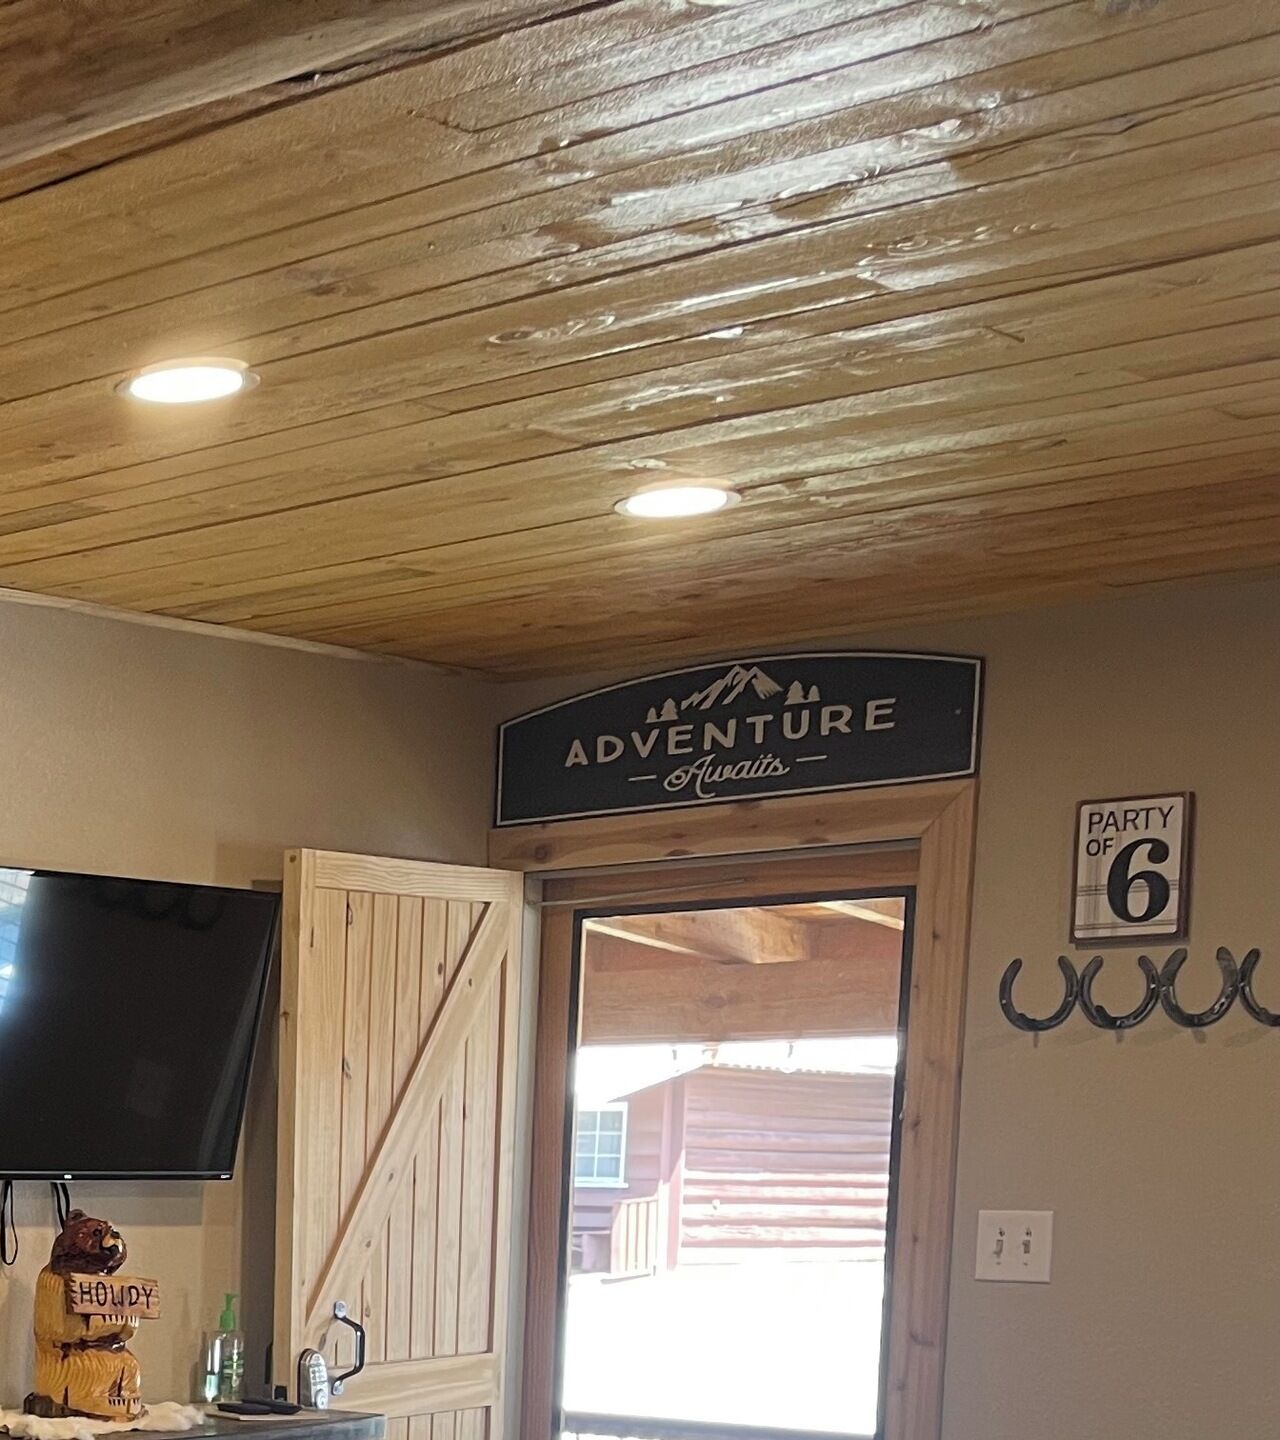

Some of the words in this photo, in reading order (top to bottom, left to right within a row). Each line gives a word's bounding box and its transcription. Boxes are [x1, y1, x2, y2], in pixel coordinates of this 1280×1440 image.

[565, 698, 897, 767] ADVENTURE
[663, 753, 790, 799] Awaits
[1087, 805, 1174, 834] PARTY
[1086, 837, 1114, 856] OF
[1107, 837, 1170, 923] 6
[79, 1281, 153, 1309] HOWDY
